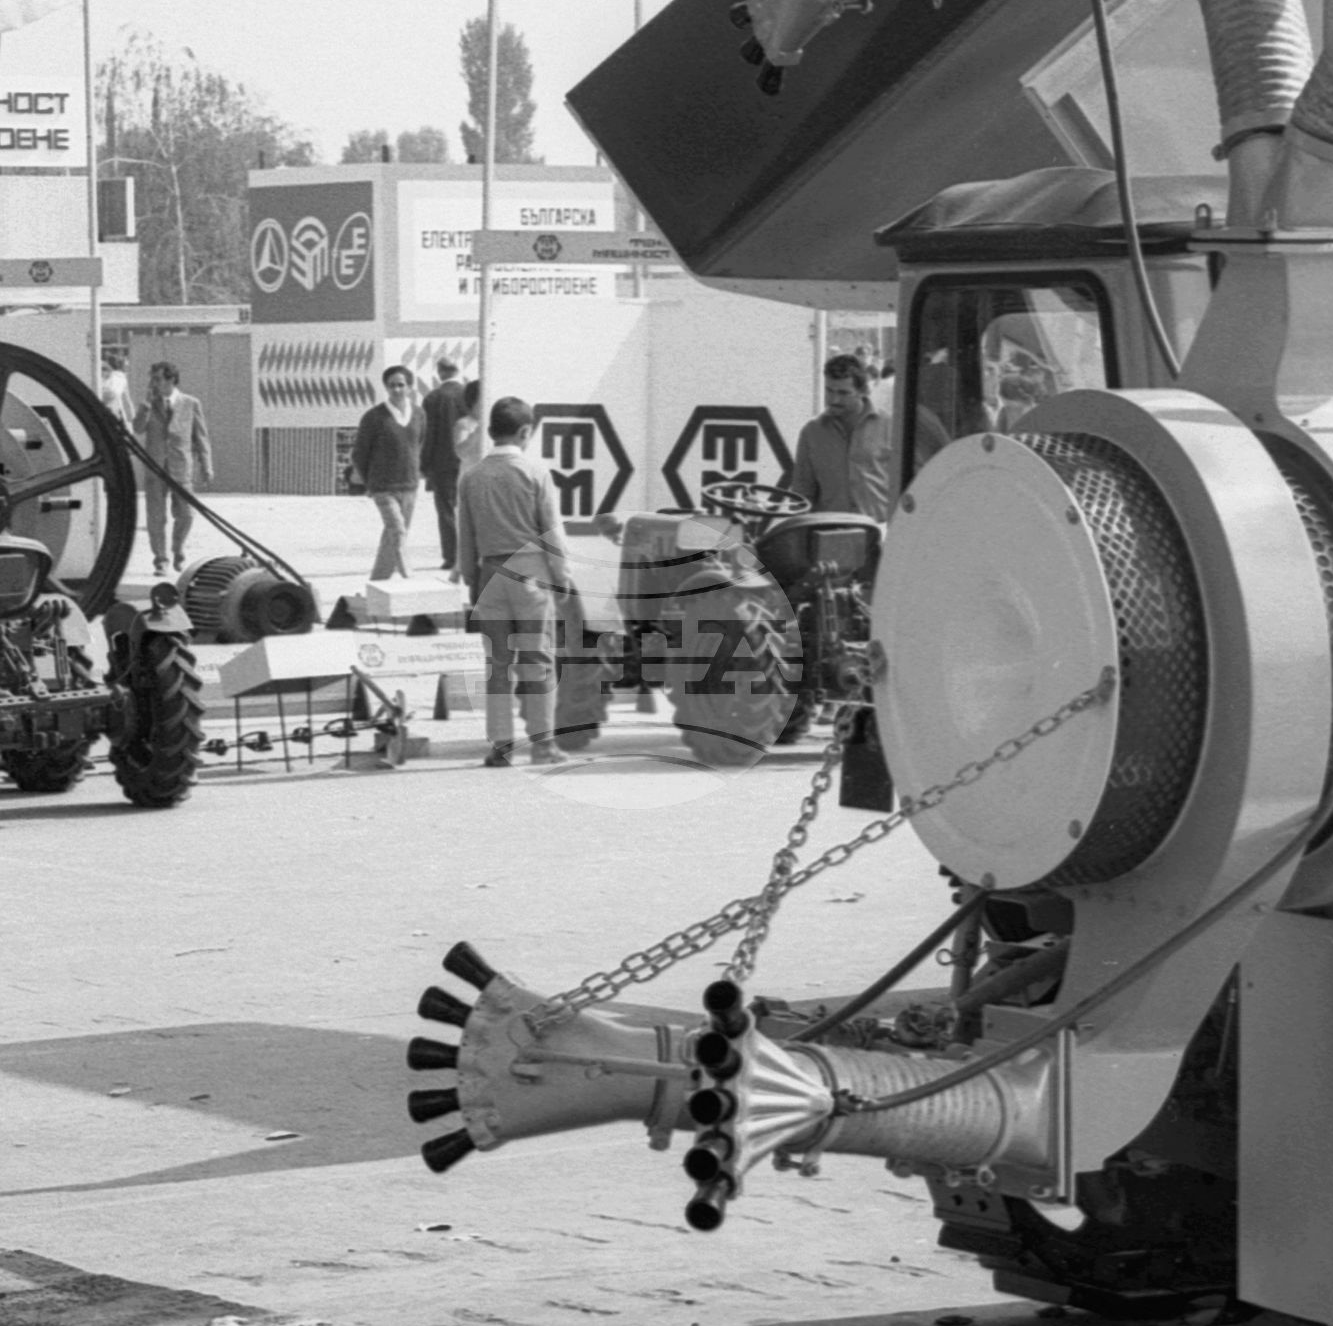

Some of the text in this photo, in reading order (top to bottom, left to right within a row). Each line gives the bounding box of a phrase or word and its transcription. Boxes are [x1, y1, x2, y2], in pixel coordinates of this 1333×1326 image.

[520, 208, 596, 226] БЪЛГАРСКА
[421, 230, 473, 249] ЕЛЕКТР
[458, 277, 598, 295] И ПИБОРОСТРОЕНЕ
